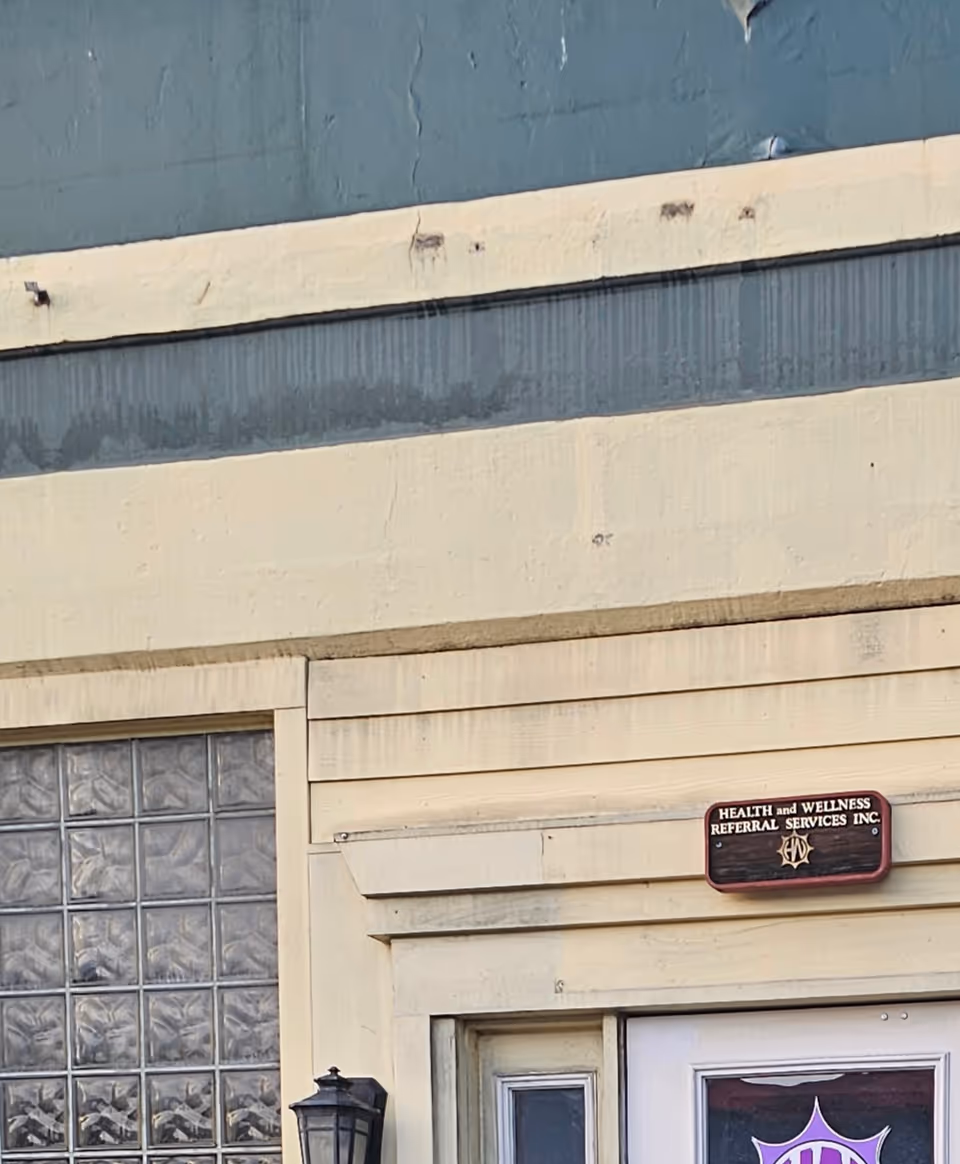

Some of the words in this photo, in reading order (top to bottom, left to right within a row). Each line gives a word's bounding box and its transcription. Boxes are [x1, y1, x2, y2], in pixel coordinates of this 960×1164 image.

[719, 805, 772, 819] HEALTH
[776, 803, 797, 815] and
[802, 798, 871, 814] WELLNESS
[711, 819, 779, 835] REFERRAL
[785, 813, 847, 830] SERVICES
[853, 812, 881, 825] INC.
